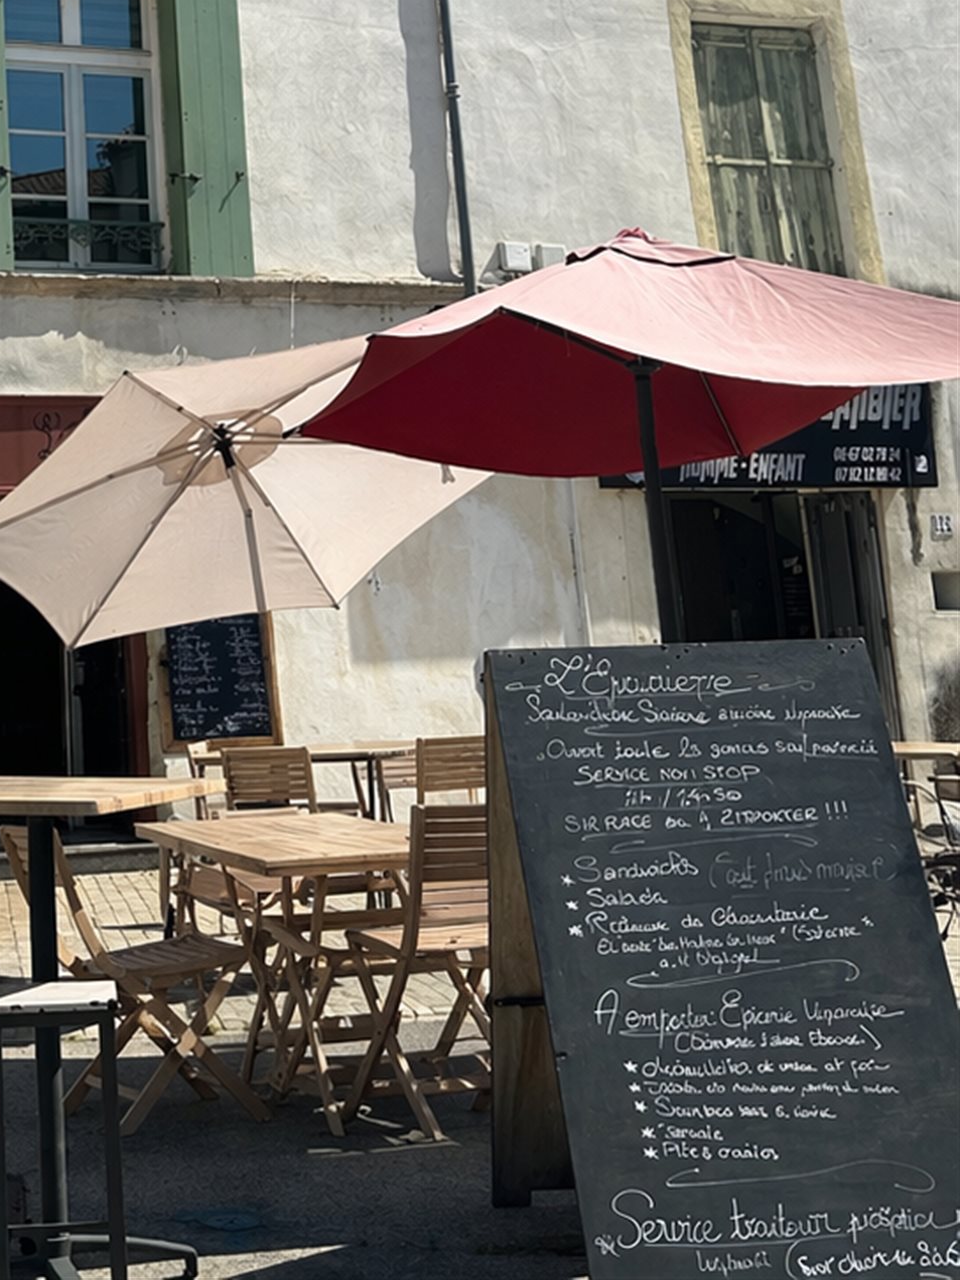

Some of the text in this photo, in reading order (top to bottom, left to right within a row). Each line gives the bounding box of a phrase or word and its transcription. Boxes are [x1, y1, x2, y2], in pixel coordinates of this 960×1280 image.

[748, 452, 806, 485] ENFANT
[703, 765, 761, 782] STOP
[611, 1188, 722, 1249] Service
